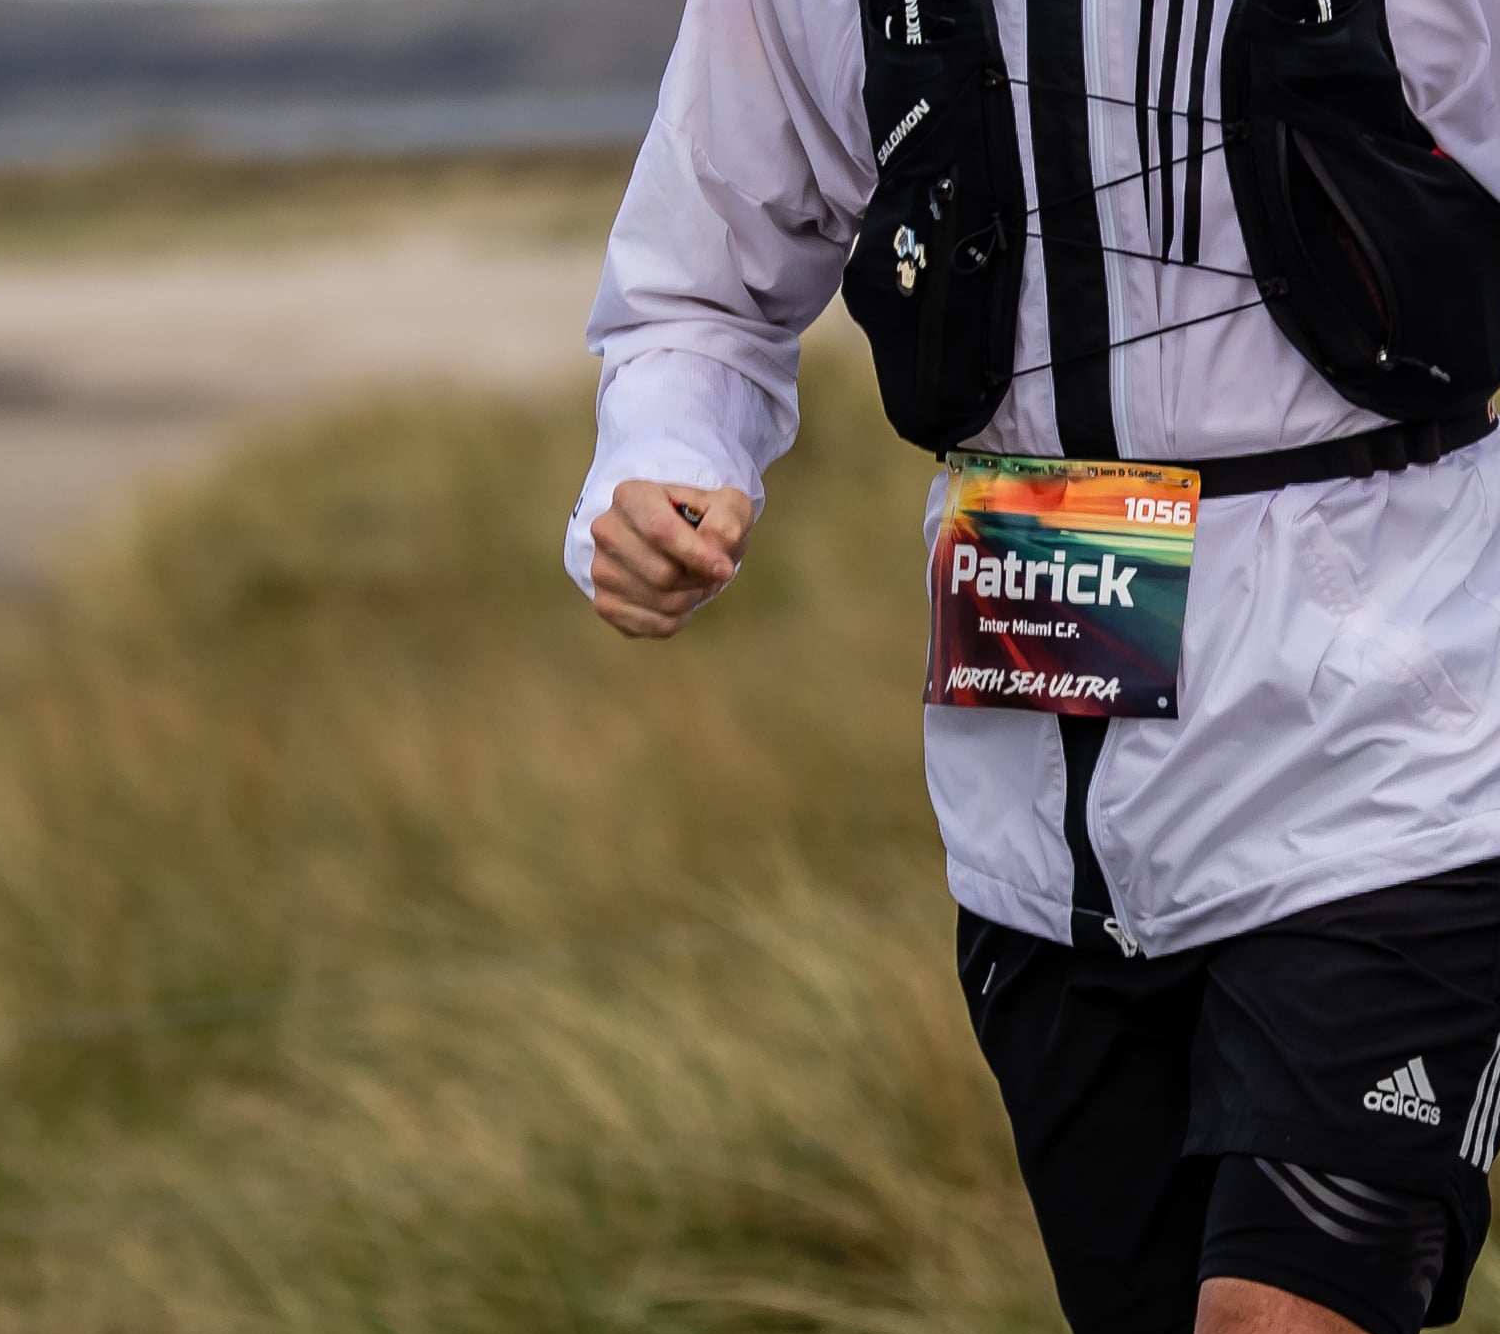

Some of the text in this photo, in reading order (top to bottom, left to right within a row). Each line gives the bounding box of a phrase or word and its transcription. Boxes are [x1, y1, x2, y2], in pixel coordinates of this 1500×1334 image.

[877, 97, 930, 166] SALOMON
[1124, 496, 1192, 527] 1056
[951, 543, 1138, 608] Patrick
[979, 616, 1080, 639] Inter Miami C.F.
[945, 662, 1121, 704] NORTH SEA ULTRA
[1363, 1090, 1441, 1126] adidas
